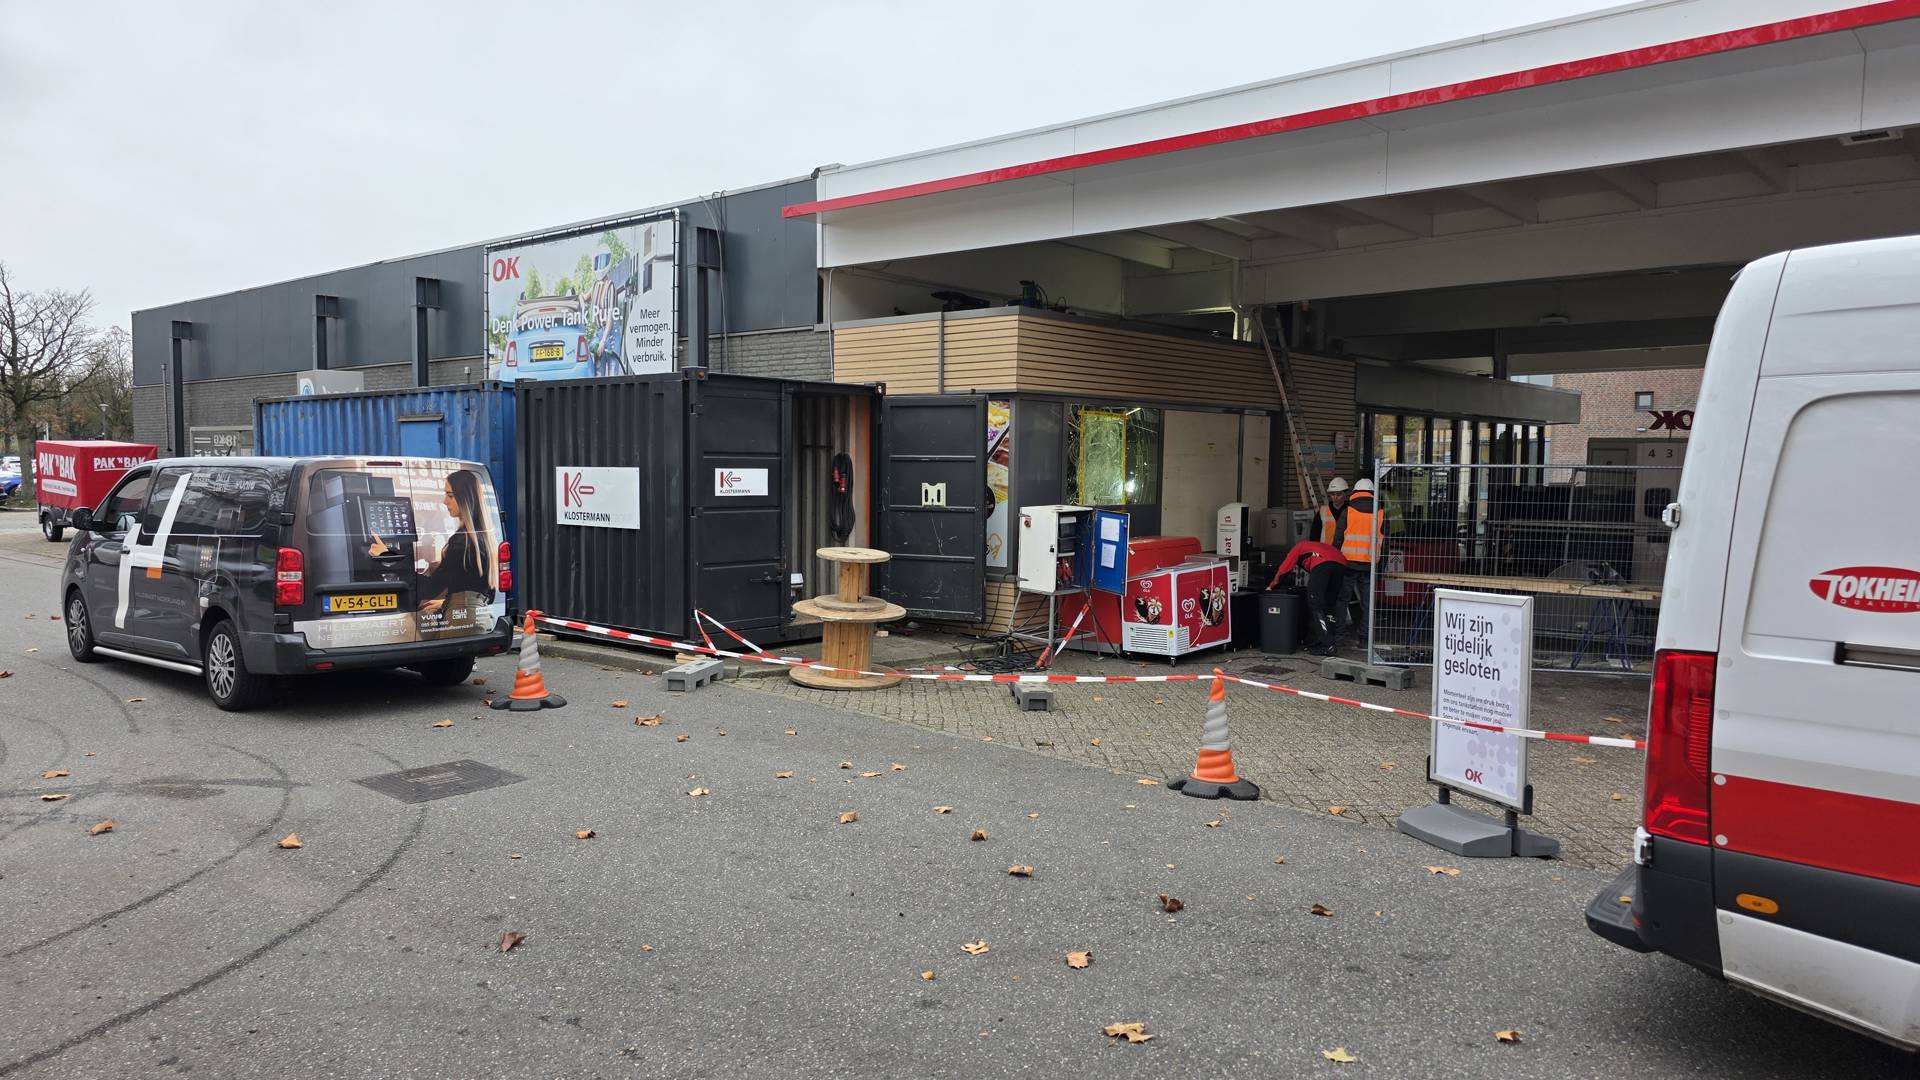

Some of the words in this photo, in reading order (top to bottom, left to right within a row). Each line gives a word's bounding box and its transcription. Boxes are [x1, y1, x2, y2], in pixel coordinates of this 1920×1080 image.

[492, 255, 520, 282] OK
[492, 317, 519, 334] Denk
[521, 315, 558, 331] Power.
[561, 309, 588, 327] Tank
[592, 305, 623, 323] Pure.
[640, 308, 661, 319] Meer
[630, 322, 671, 335] vermogen.
[636, 336, 664, 348] Minder
[632, 351, 667, 363] verbruik.
[1648, 448, 1656, 458] 4
[1666, 448, 1673, 458] 3
[40, 452, 54, 476] PAK
[59, 456, 76, 481] BAK
[94, 457, 116, 469] PAK
[564, 511, 611, 522] KLOSTERMANN
[1271, 519, 1277, 529] 5
[1817, 574, 1920, 603] TOKHEI
[334, 596, 393, 609] V-54-GLH
[1445, 611, 1465, 635] Wij
[1469, 615, 1494, 638] zijn
[392, 628, 407, 636] BV
[1444, 633, 1493, 660] tijdelijk
[1444, 657, 1500, 681] gesloten
[1464, 768, 1483, 785] OK
